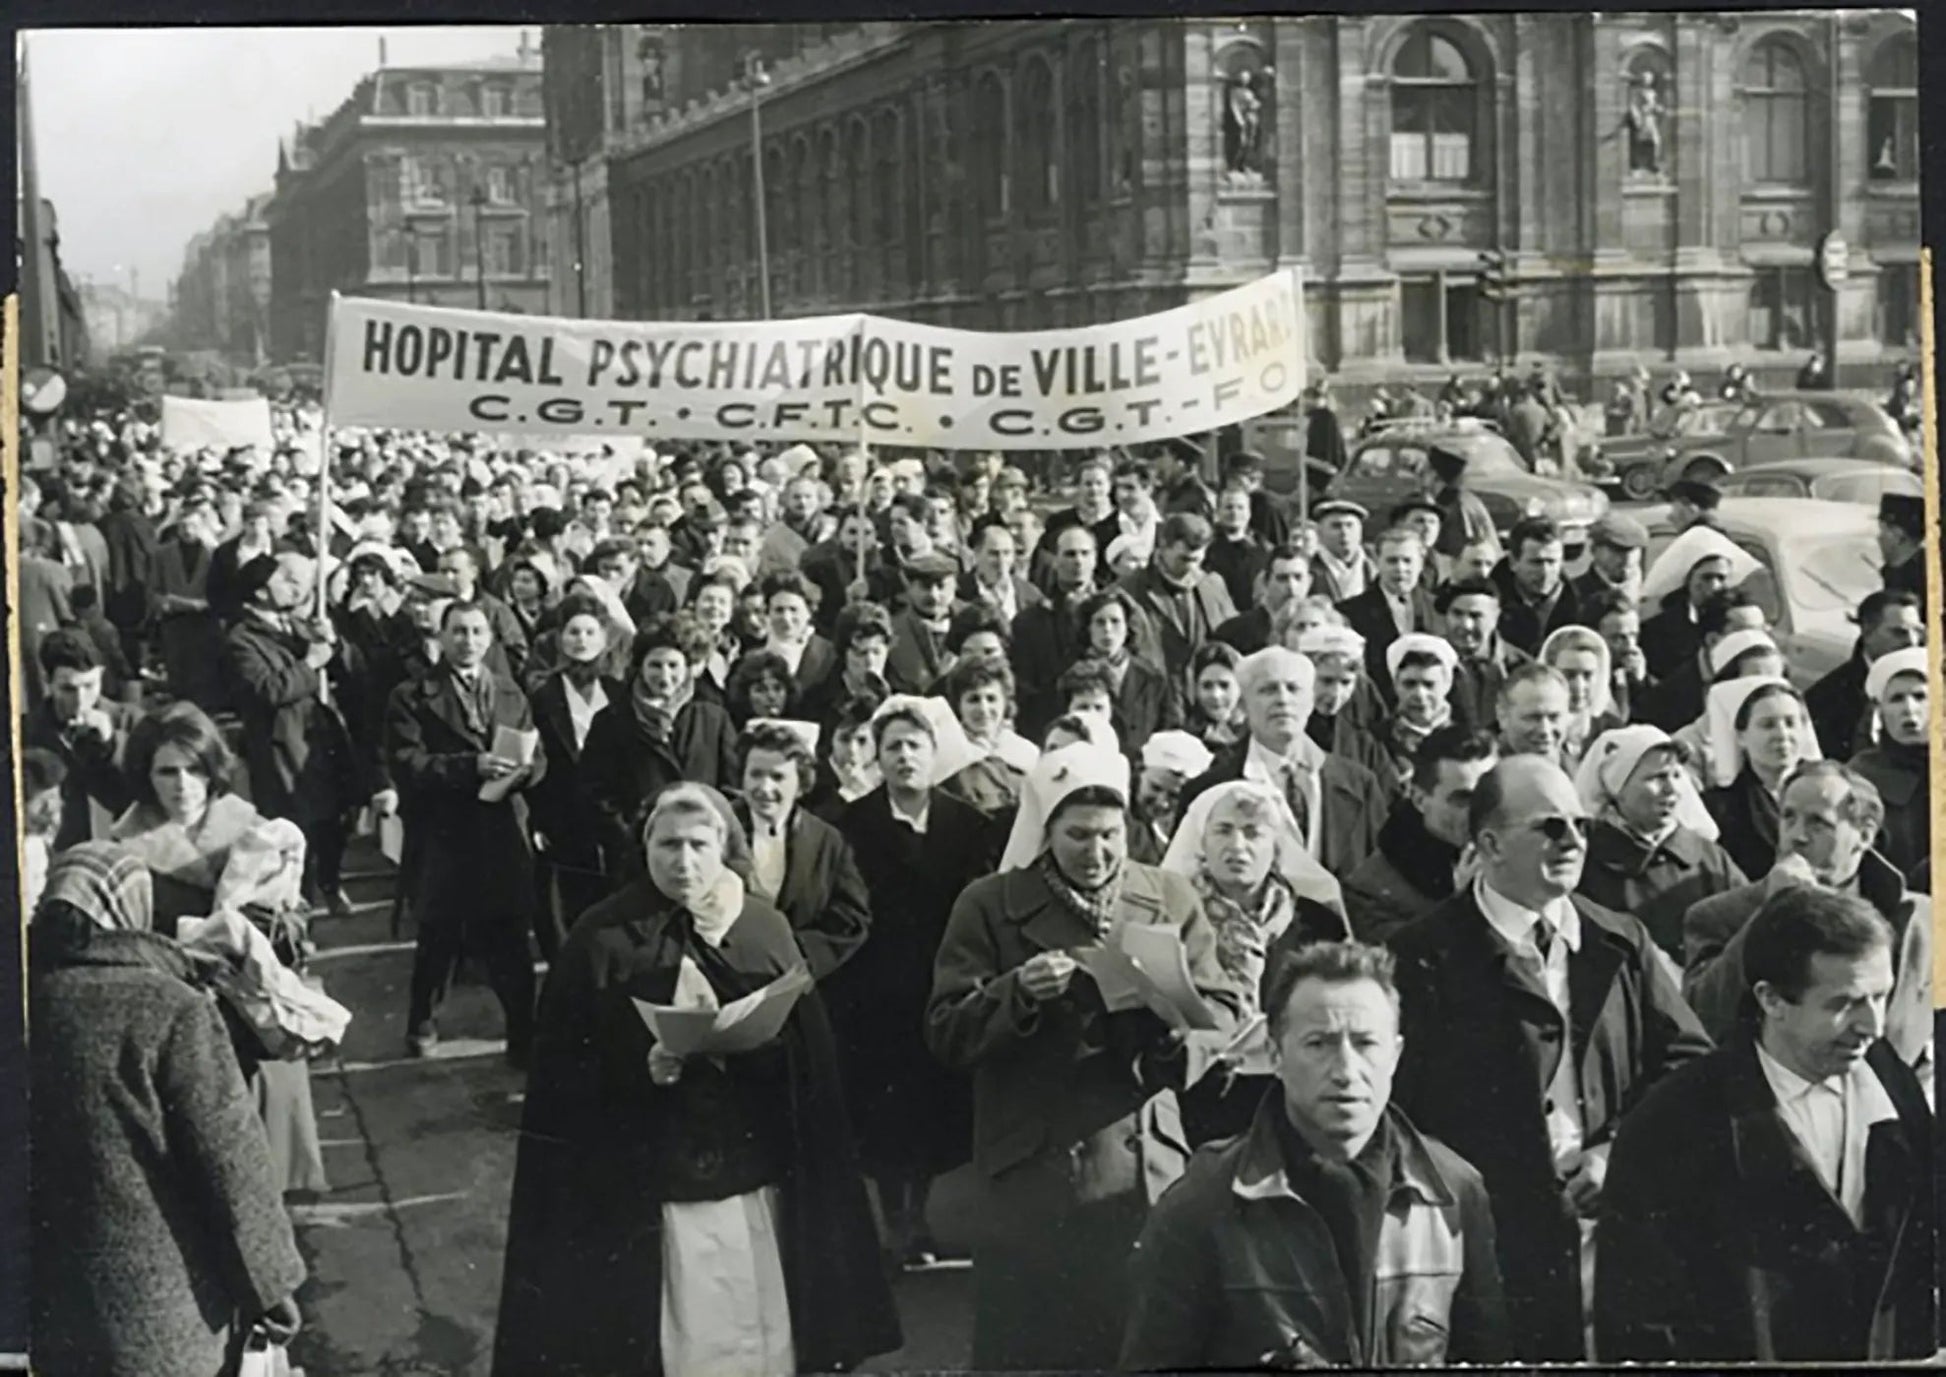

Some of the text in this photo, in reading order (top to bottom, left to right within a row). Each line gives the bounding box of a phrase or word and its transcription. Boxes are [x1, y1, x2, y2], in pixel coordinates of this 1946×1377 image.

[363, 319, 563, 386] HOPITAL
[587, 334, 954, 395] PSYCHIATRIQUE
[972, 364, 1022, 398] DE
[468, 394, 657, 427] C.G.T.
